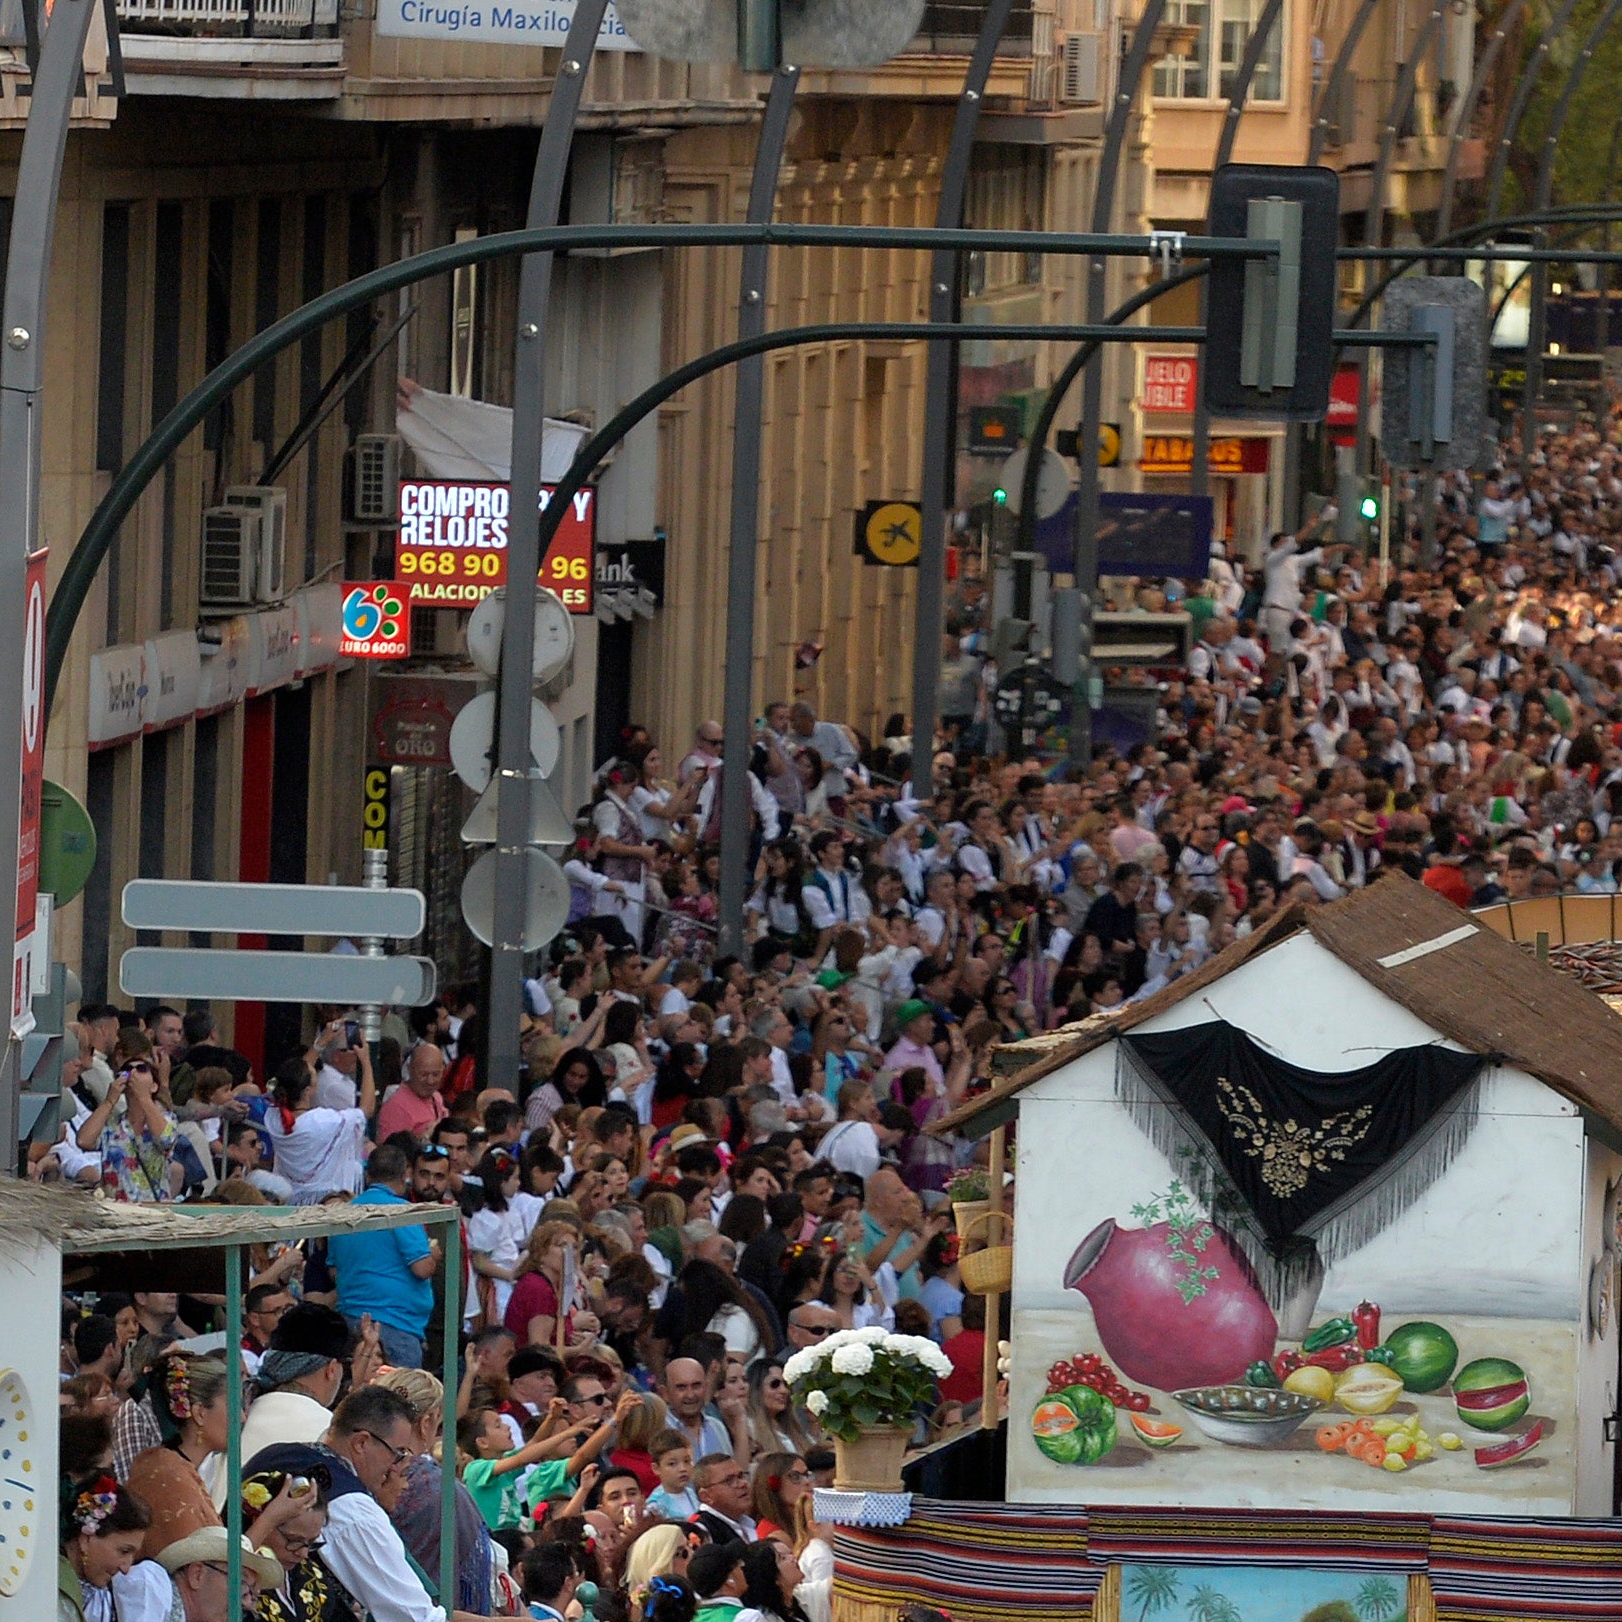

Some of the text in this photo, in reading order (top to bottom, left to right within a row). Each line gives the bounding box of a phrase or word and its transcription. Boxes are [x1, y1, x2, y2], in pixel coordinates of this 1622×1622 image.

[400, 1, 482, 31] Cirugía
[1144, 438, 1242, 462] TABAOS
[400, 484, 509, 519] COMPRO
[572, 491, 592, 522] Y
[400, 515, 509, 549] RELOJES
[399, 551, 588, 580] 968 90 96
[595, 551, 636, 582] ank
[371, 641, 407, 655] 6000
[364, 770, 387, 850] COM
